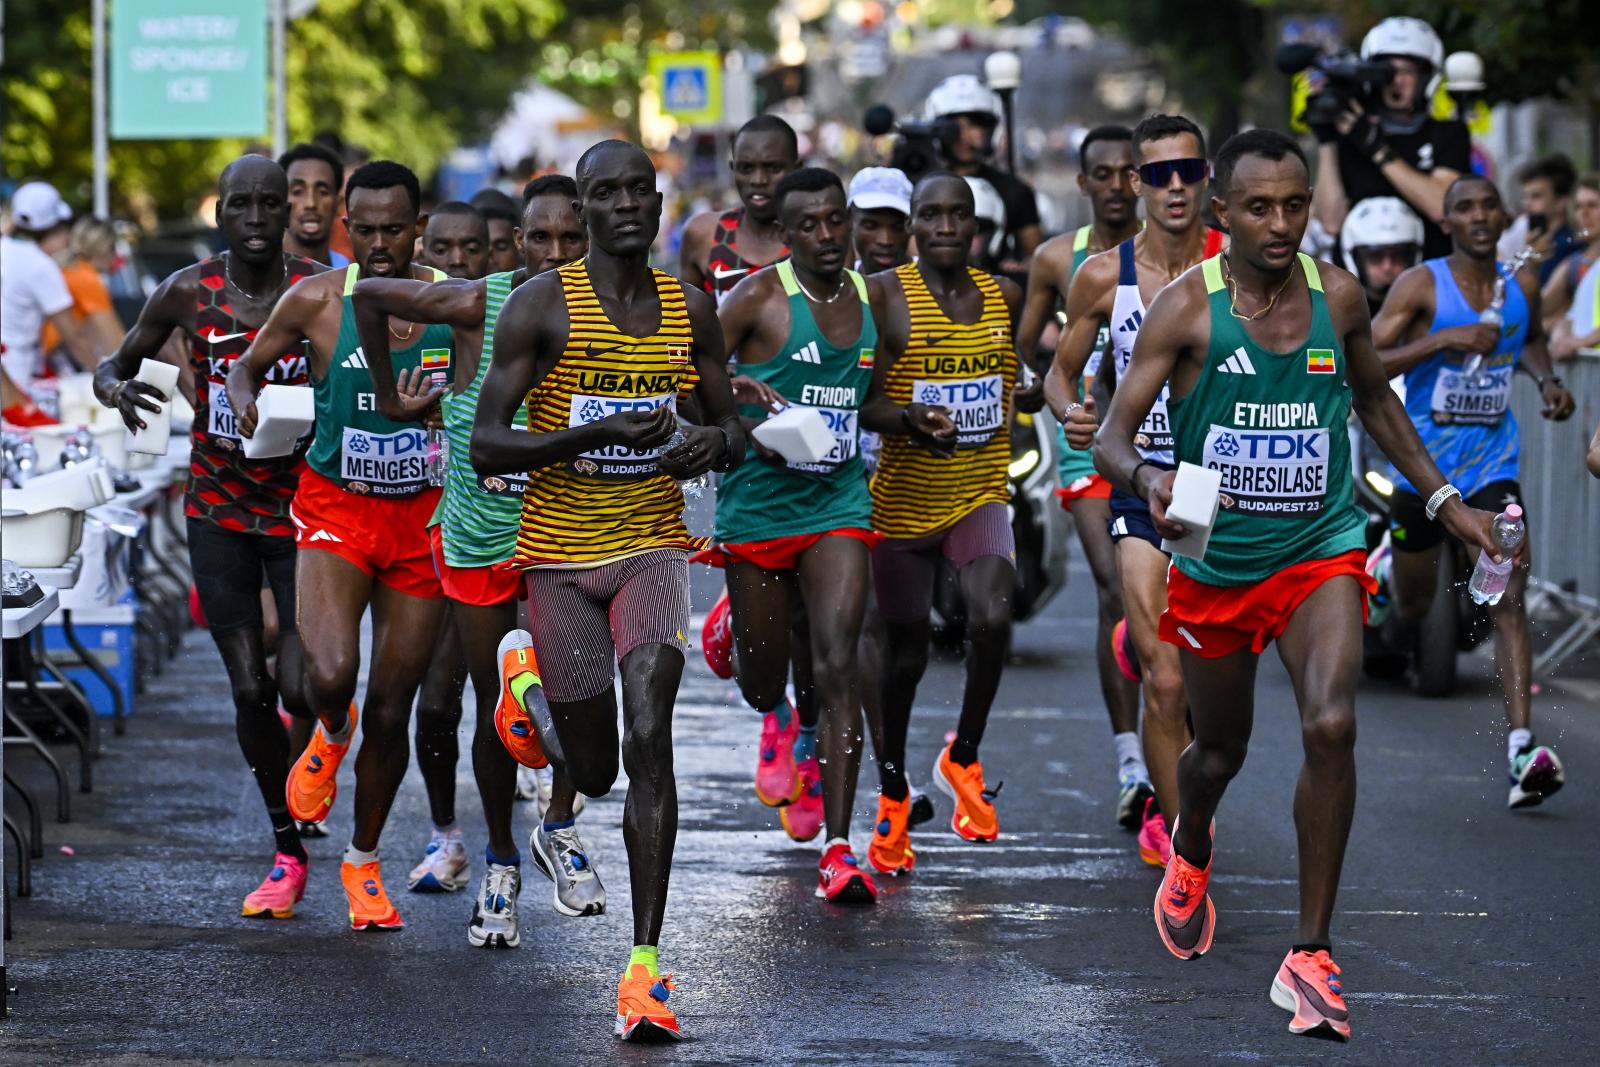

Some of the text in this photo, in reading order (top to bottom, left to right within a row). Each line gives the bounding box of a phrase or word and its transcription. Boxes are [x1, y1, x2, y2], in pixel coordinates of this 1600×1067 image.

[167, 76, 209, 102] ICE
[208, 357, 309, 381] KYA
[925, 354, 1004, 374] UGAND
[942, 379, 998, 403] TDK
[1444, 393, 1504, 411] SIMBU
[1234, 402, 1318, 427] ETHIOPIA
[1240, 433, 1320, 459] TDK
[1238, 500, 1320, 512] BUDAPEST 23
